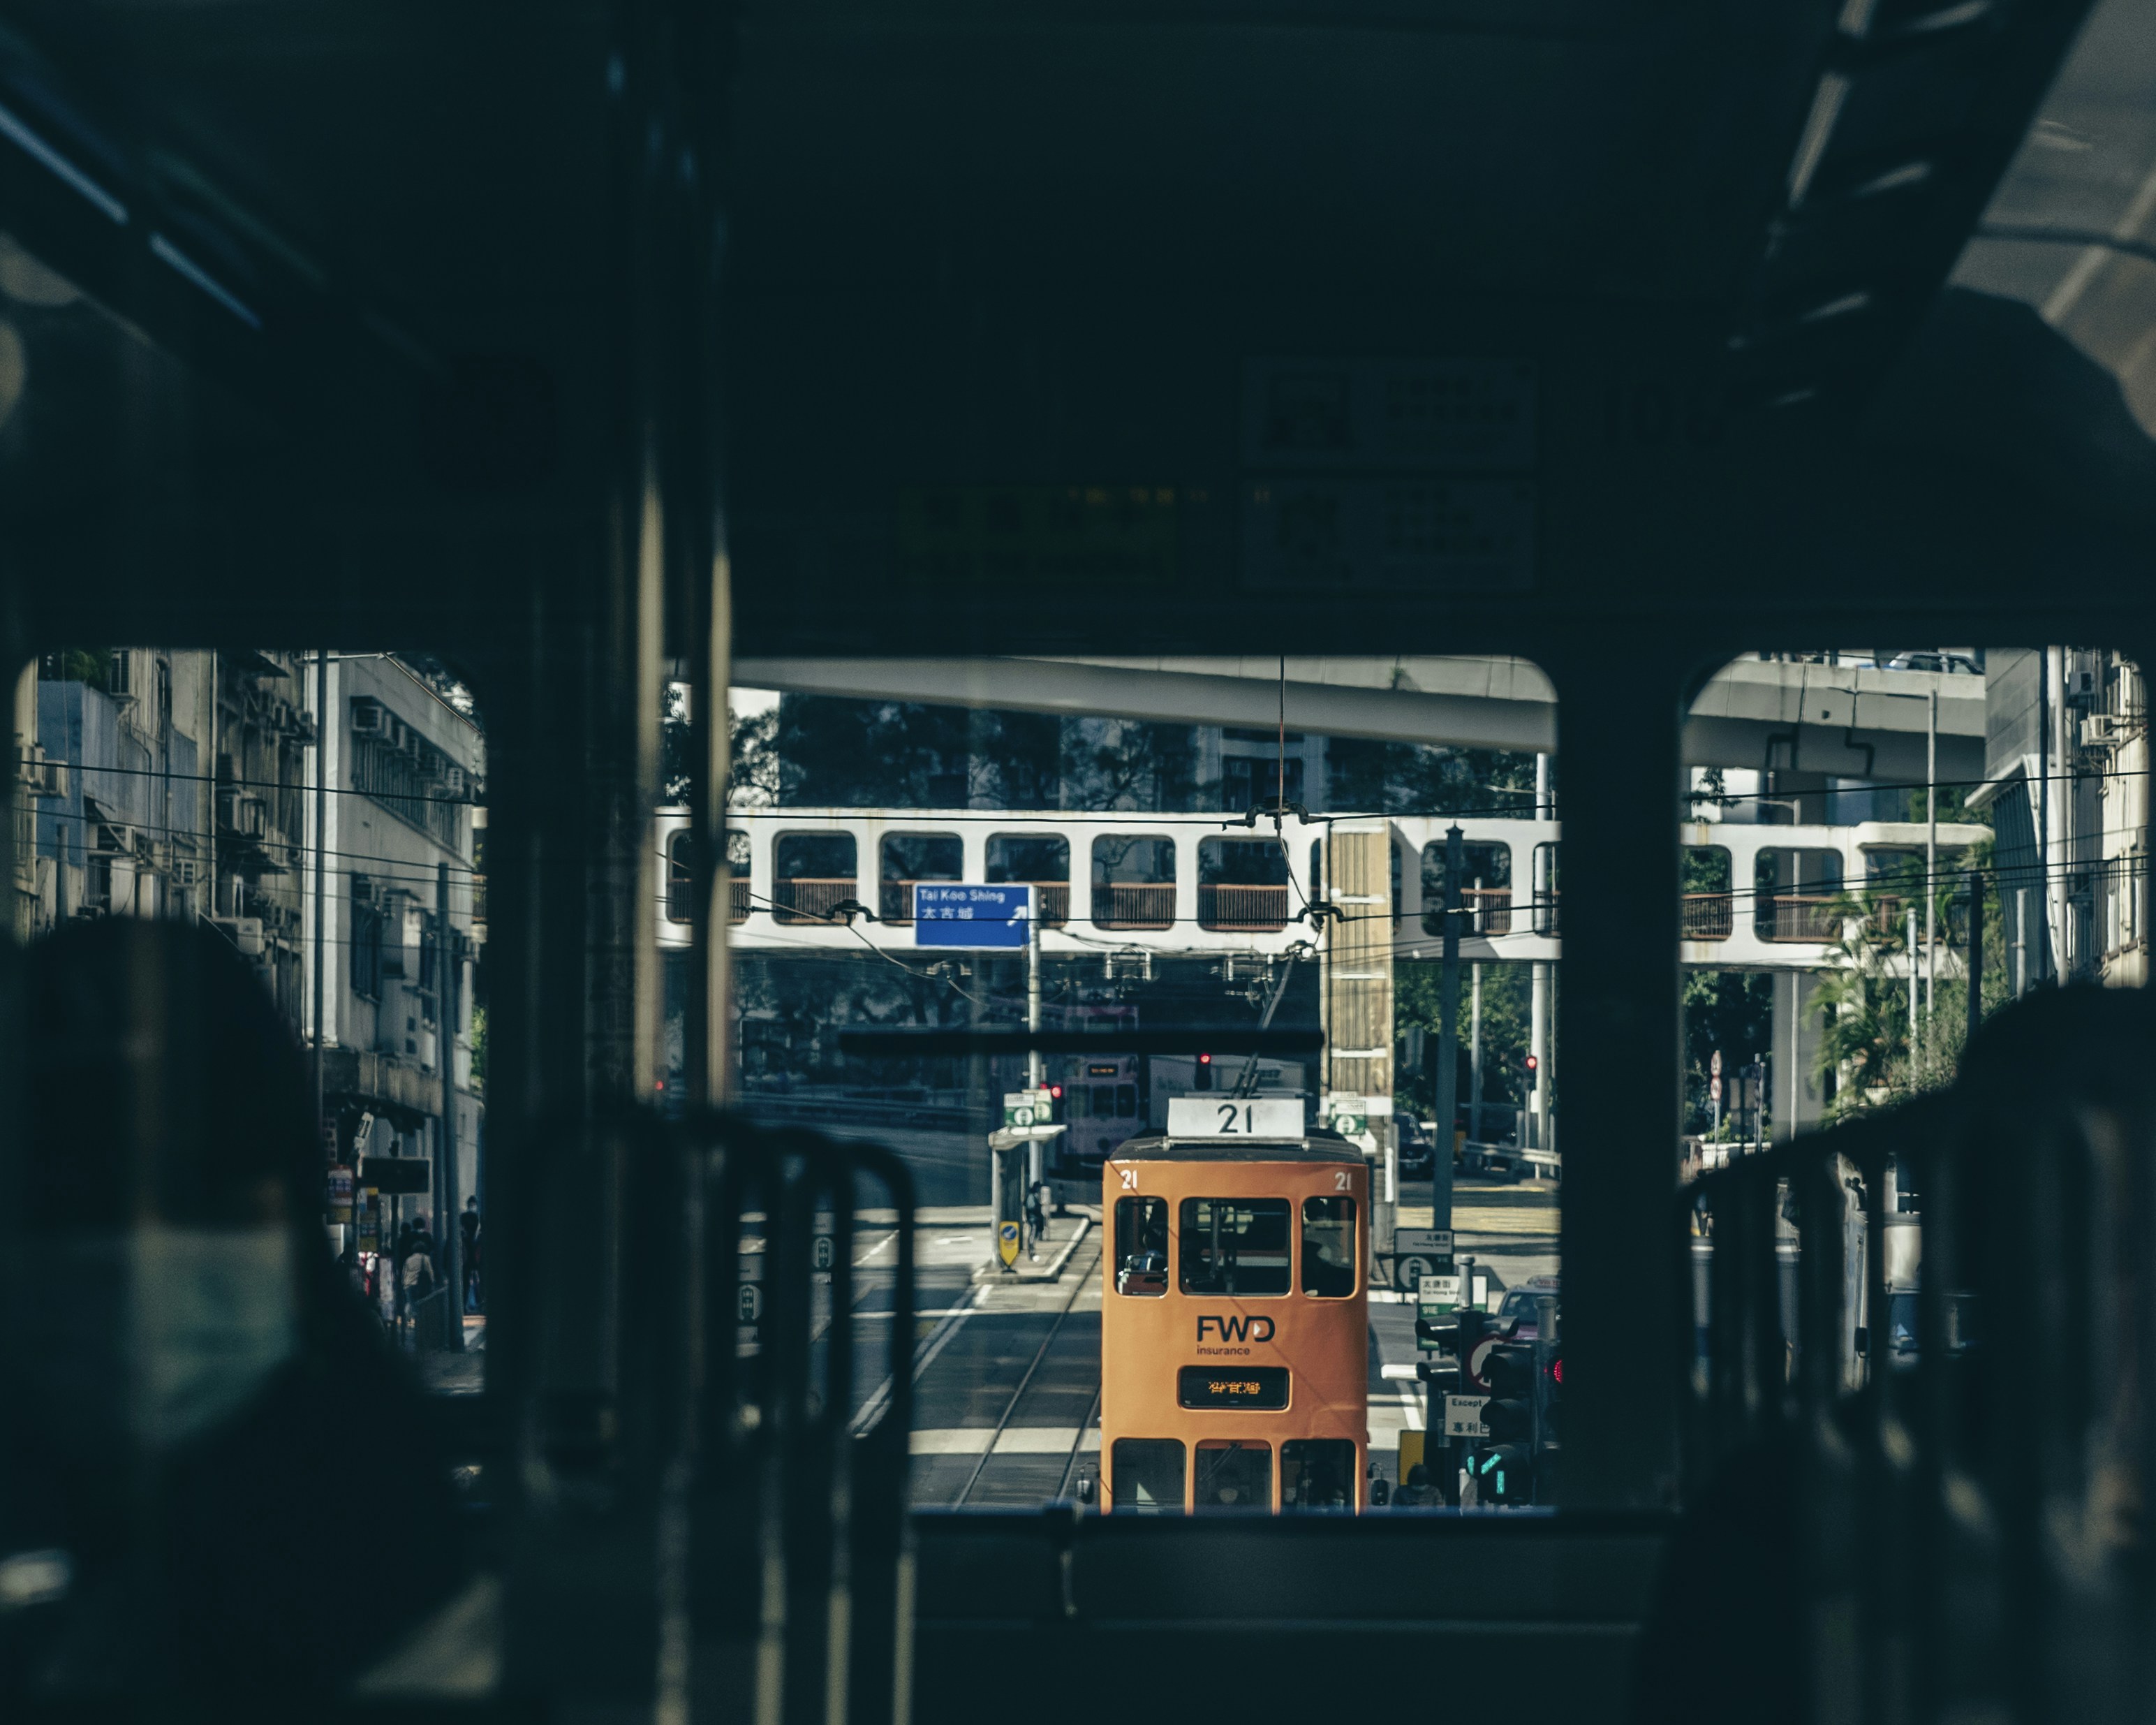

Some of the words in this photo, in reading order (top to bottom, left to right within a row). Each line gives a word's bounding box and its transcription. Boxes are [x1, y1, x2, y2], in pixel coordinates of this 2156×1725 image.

[920, 888, 939, 902] Tai
[940, 888, 968, 902] Koo
[969, 888, 1006, 904] Shing
[921, 906, 974, 920] 太古城
[1217, 1103, 1253, 1134] 21
[1121, 1169, 1137, 1190] 21
[1334, 1171, 1352, 1191] 21
[1197, 1315, 1276, 1342] FWD
[1197, 1345, 1250, 1356] insurance
[1452, 1398, 1482, 1408] Except
